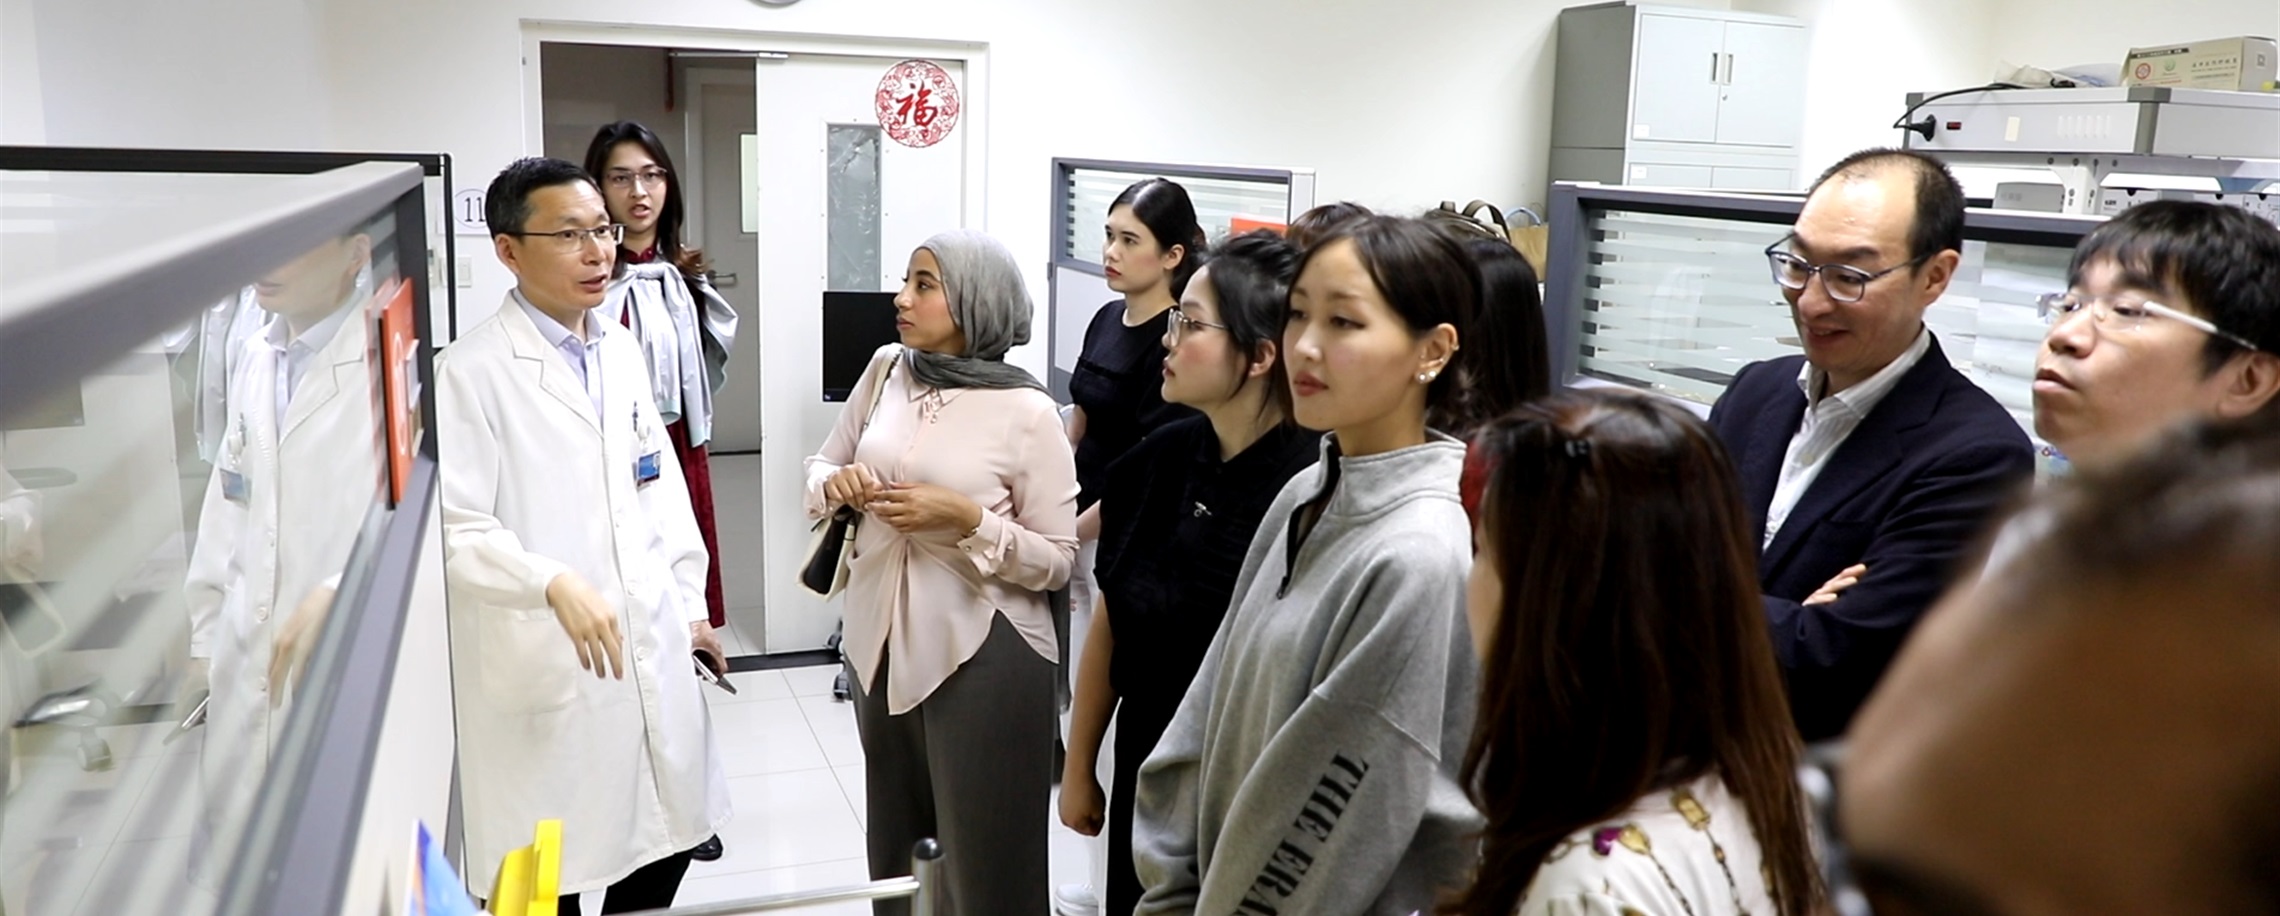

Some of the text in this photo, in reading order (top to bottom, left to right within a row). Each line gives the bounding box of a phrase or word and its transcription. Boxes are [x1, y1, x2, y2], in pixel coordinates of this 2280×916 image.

[895, 80, 938, 127] 福
[464, 196, 486, 223] 11
[1293, 752, 1370, 843] THE
